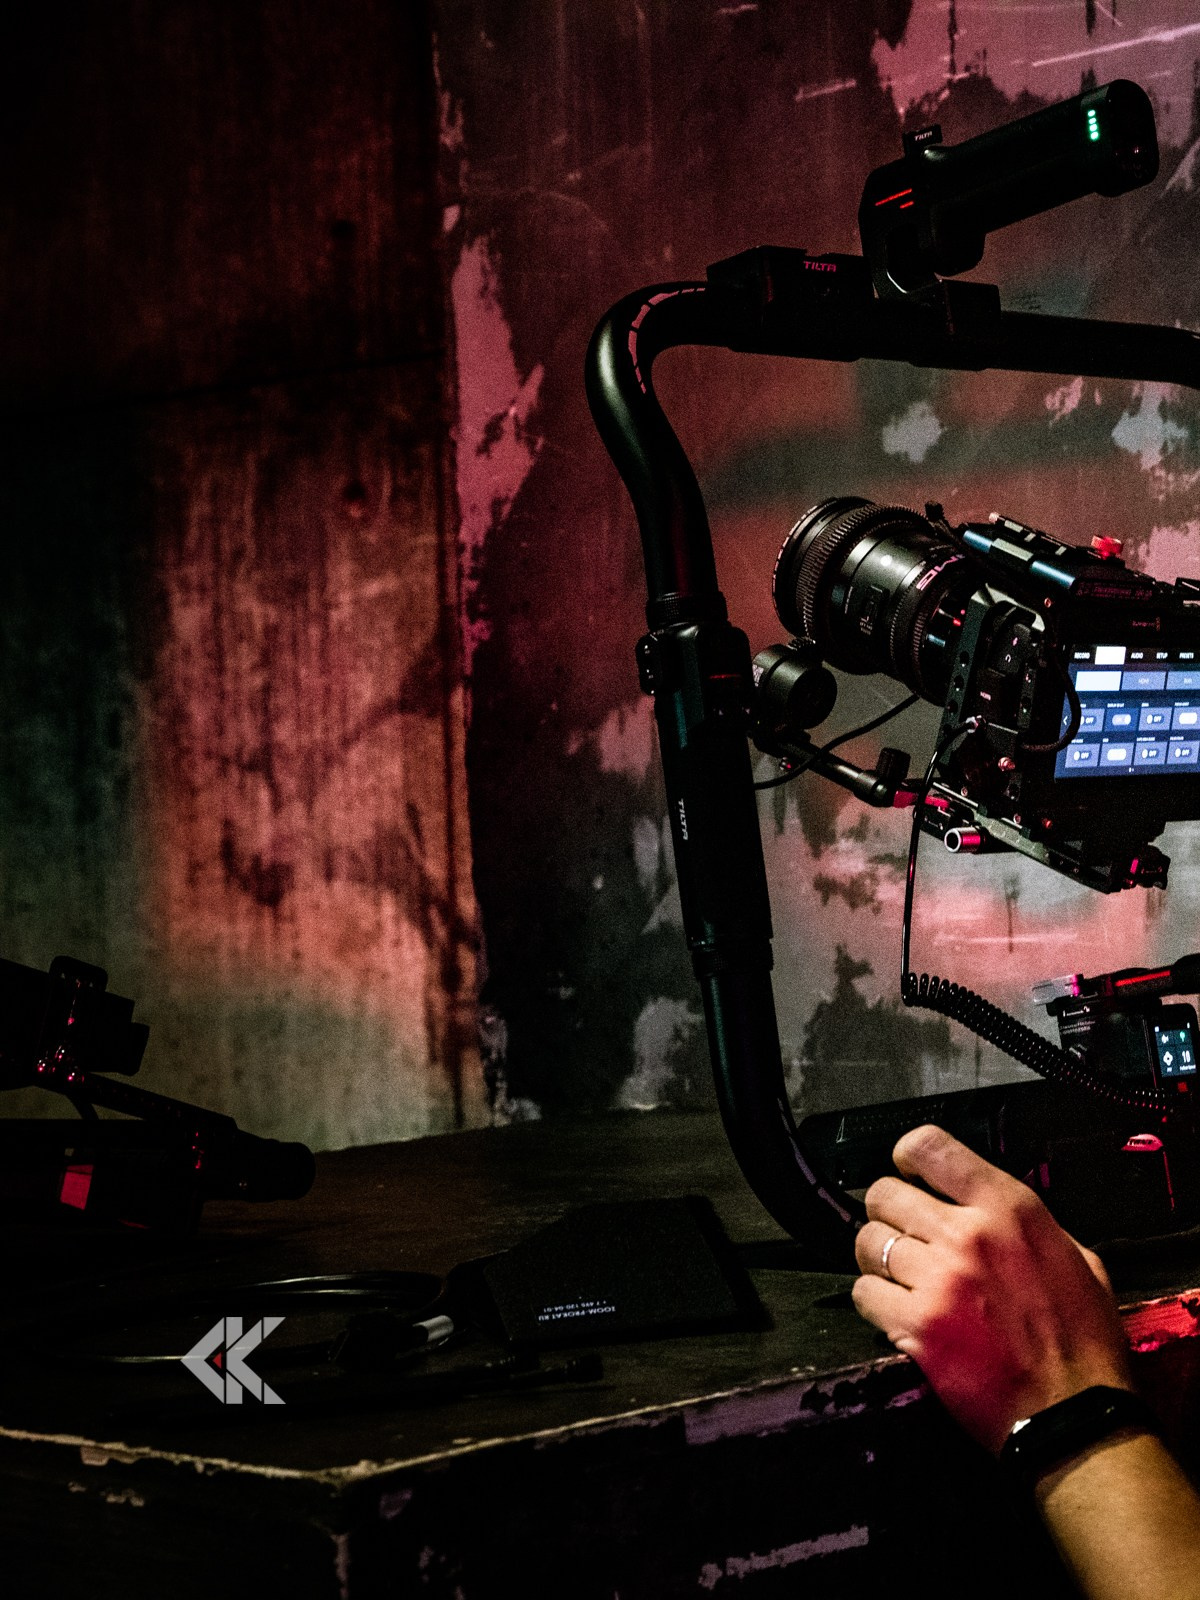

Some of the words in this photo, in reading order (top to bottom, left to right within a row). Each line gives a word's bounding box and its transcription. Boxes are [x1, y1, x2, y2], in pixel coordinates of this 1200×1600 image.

[802, 260, 838, 273] TILTA
[1130, 651, 1144, 660] AUDIO
[1085, 716, 1095, 725] OFF
[1153, 715, 1162, 723] OFF
[1149, 749, 1158, 758] OFF
[678, 798, 689, 840] TILTA
